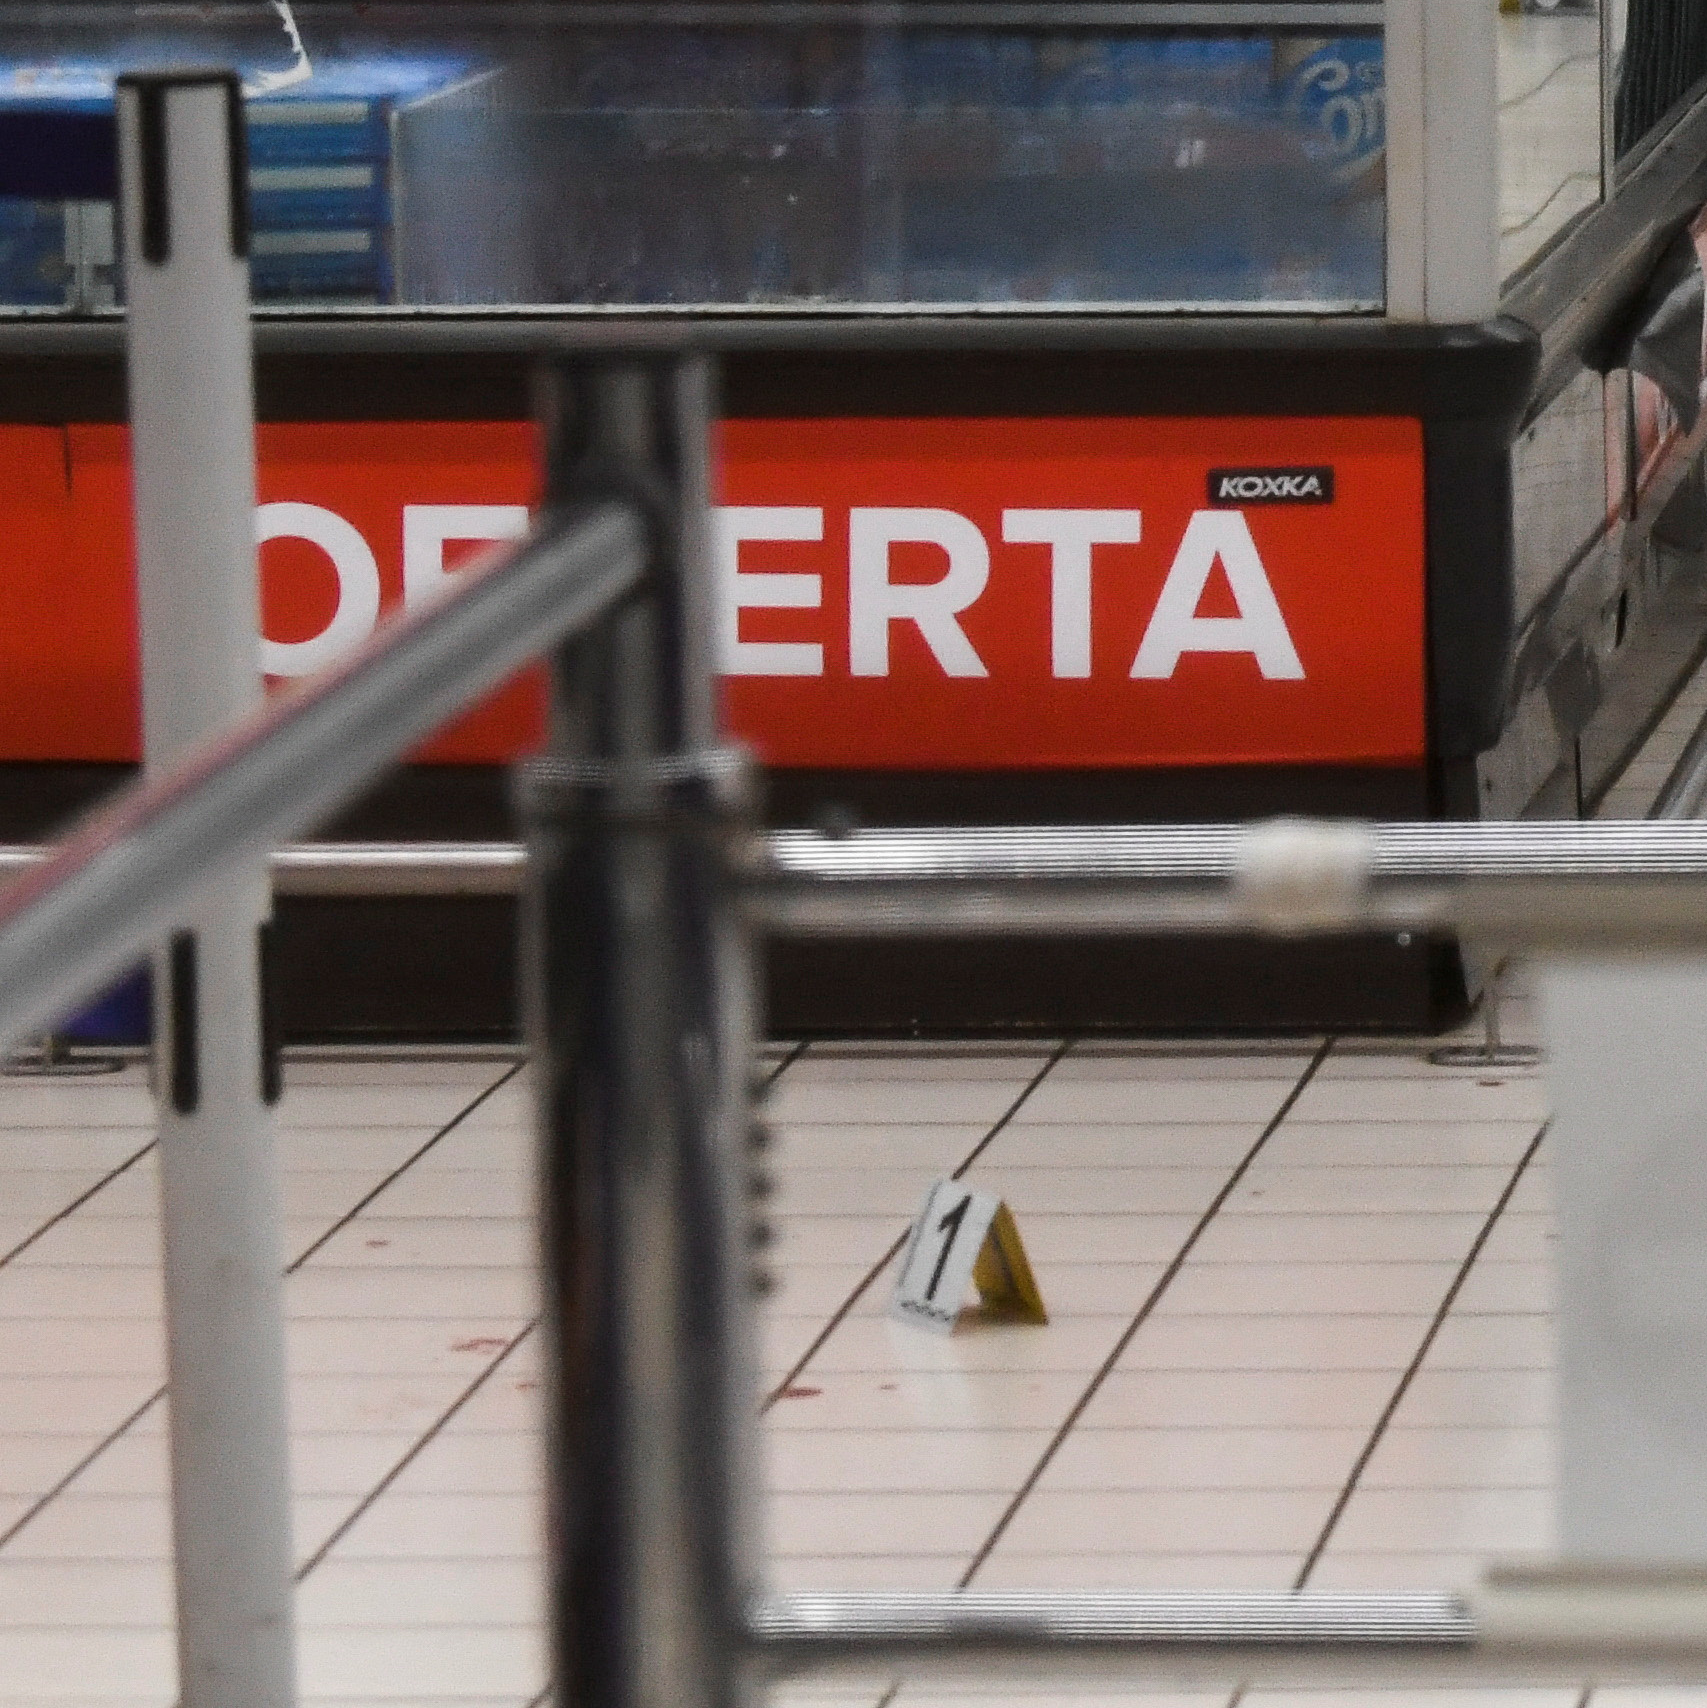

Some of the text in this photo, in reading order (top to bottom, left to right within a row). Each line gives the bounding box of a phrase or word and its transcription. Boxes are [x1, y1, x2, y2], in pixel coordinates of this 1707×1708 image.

[1219, 475, 1322, 498] KOXKA
[258, 501, 1308, 680] OFERTA
[926, 1194, 972, 1301] 1
